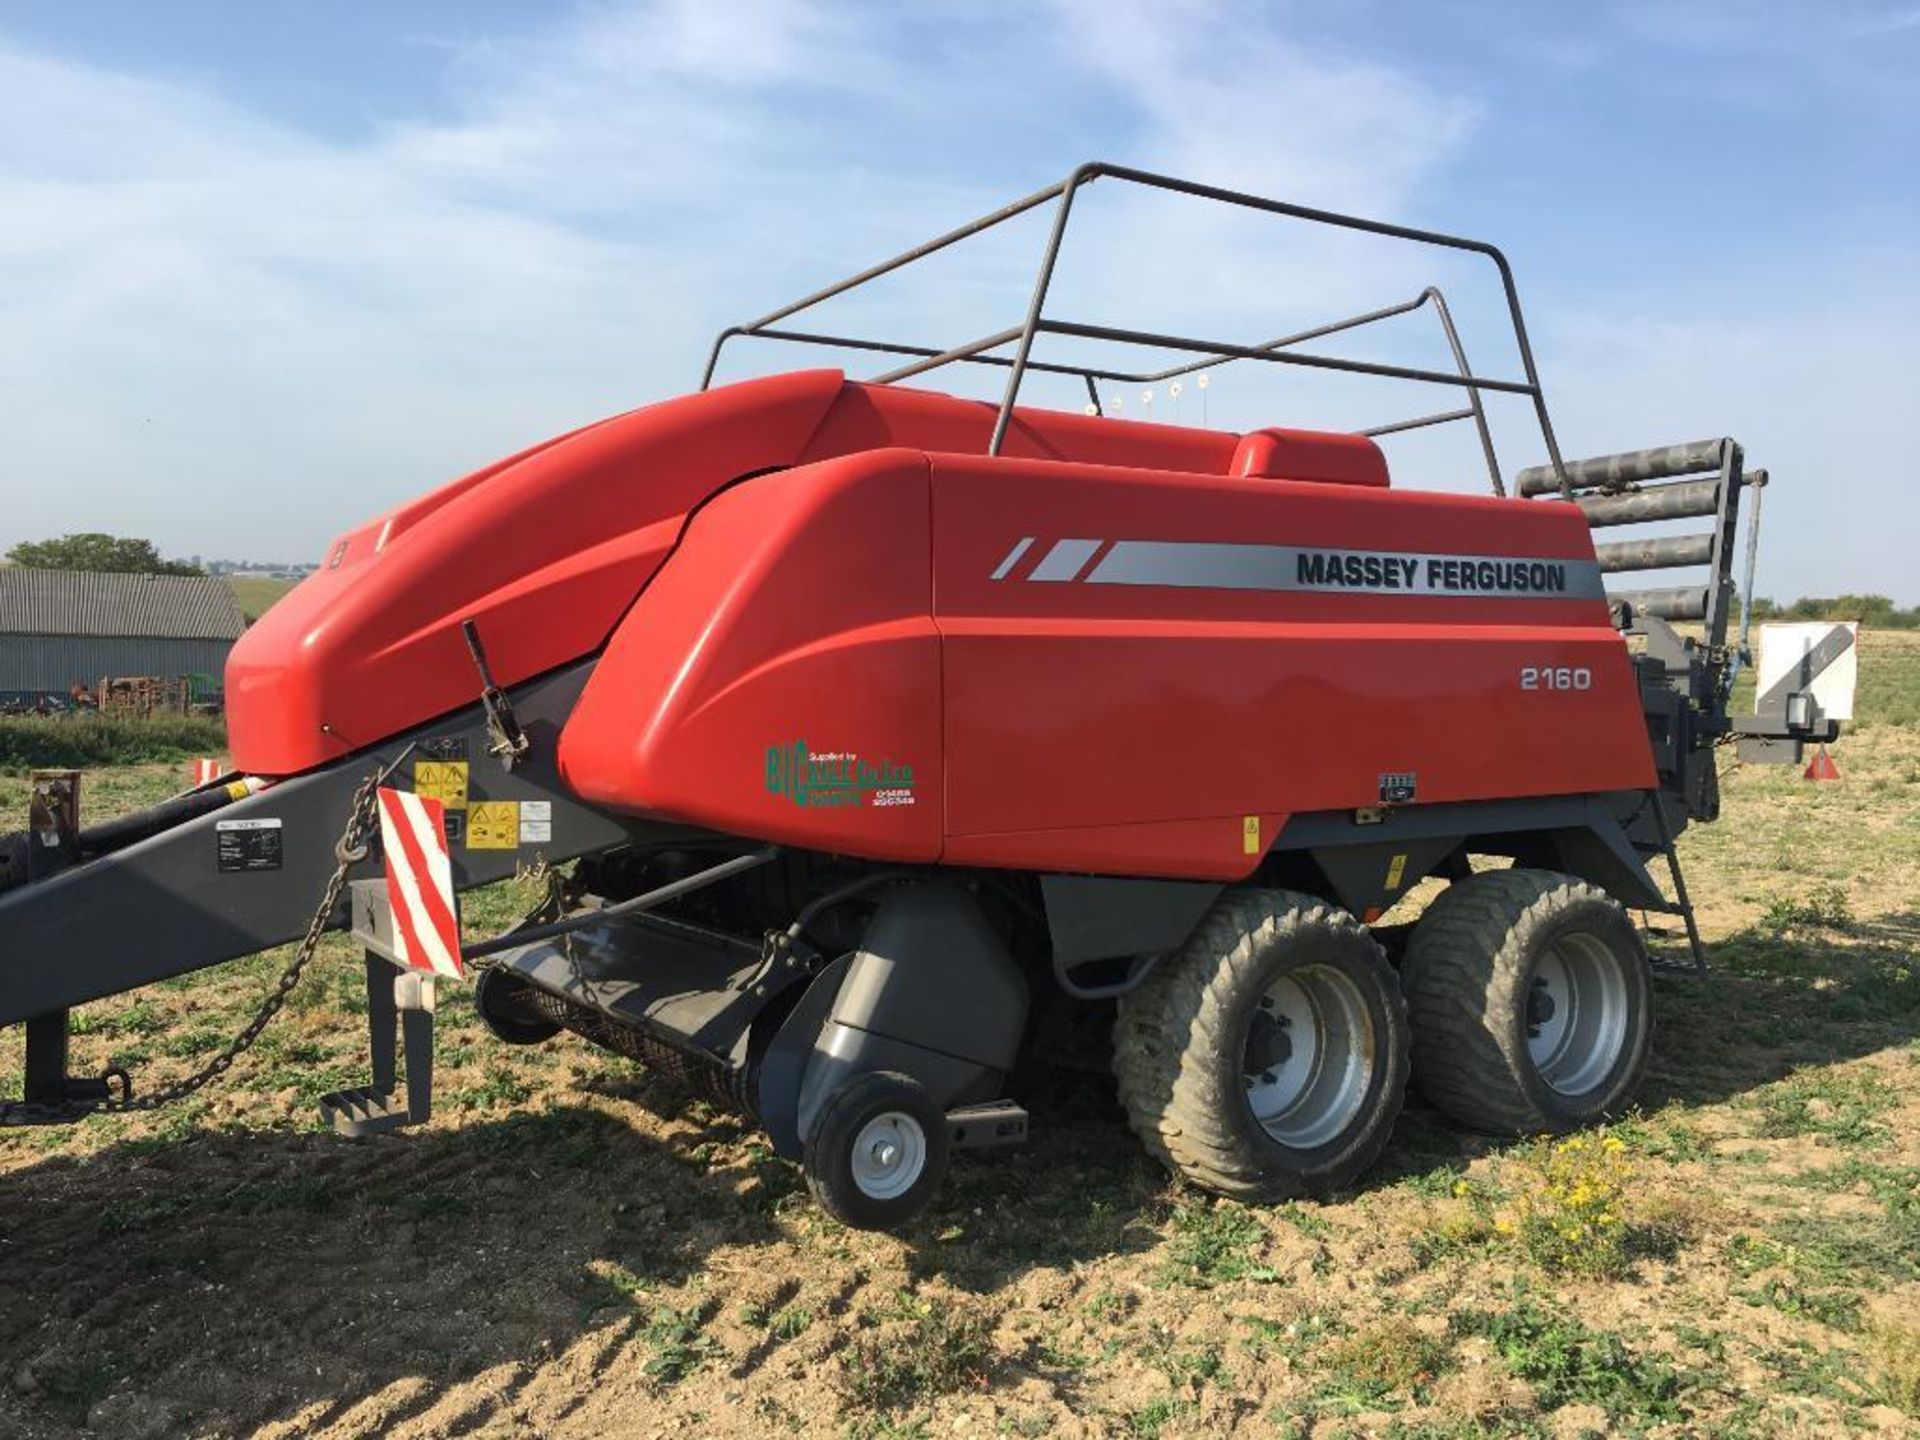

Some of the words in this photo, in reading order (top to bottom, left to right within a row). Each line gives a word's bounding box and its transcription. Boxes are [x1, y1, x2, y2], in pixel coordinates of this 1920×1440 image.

[1297, 554, 1418, 588] MASSEY
[1427, 559, 1565, 591] FERGUSON
[1520, 667, 1592, 690] 2160
